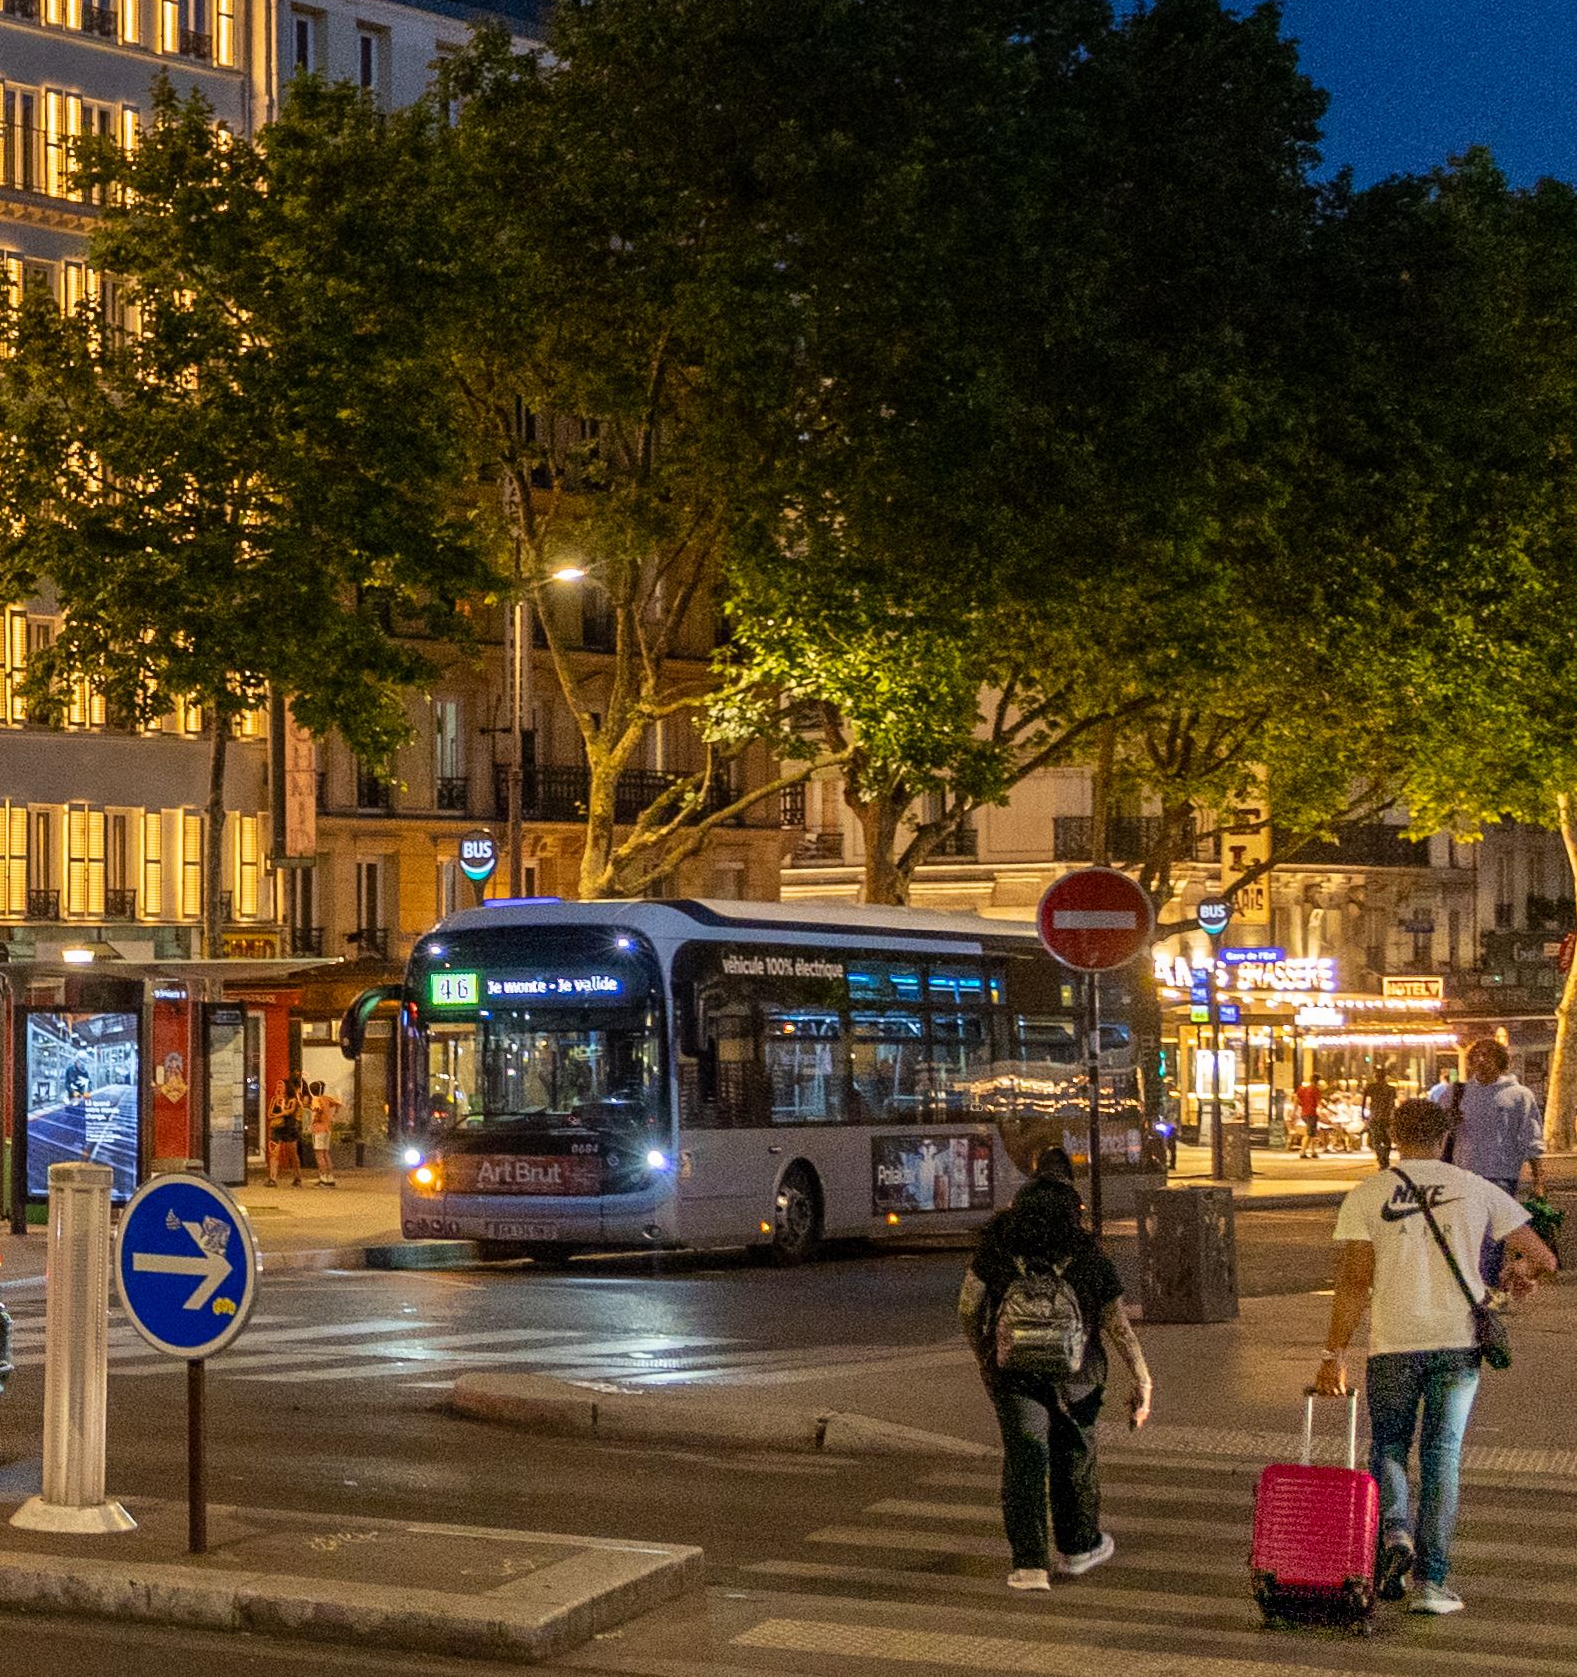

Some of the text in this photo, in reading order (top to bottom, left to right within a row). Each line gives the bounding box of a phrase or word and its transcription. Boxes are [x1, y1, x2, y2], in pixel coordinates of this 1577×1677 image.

[462, 840, 493, 859] BUS
[1199, 904, 1227, 919] BUS
[766, 956, 794, 976] 100%
[440, 979, 469, 1000] 46
[504, 980, 547, 994] monte
[574, 975, 618, 992] valide
[1387, 982, 1431, 996] HOTEL
[478, 1160, 513, 1183] Art
[515, 1161, 562, 1184] Brut
